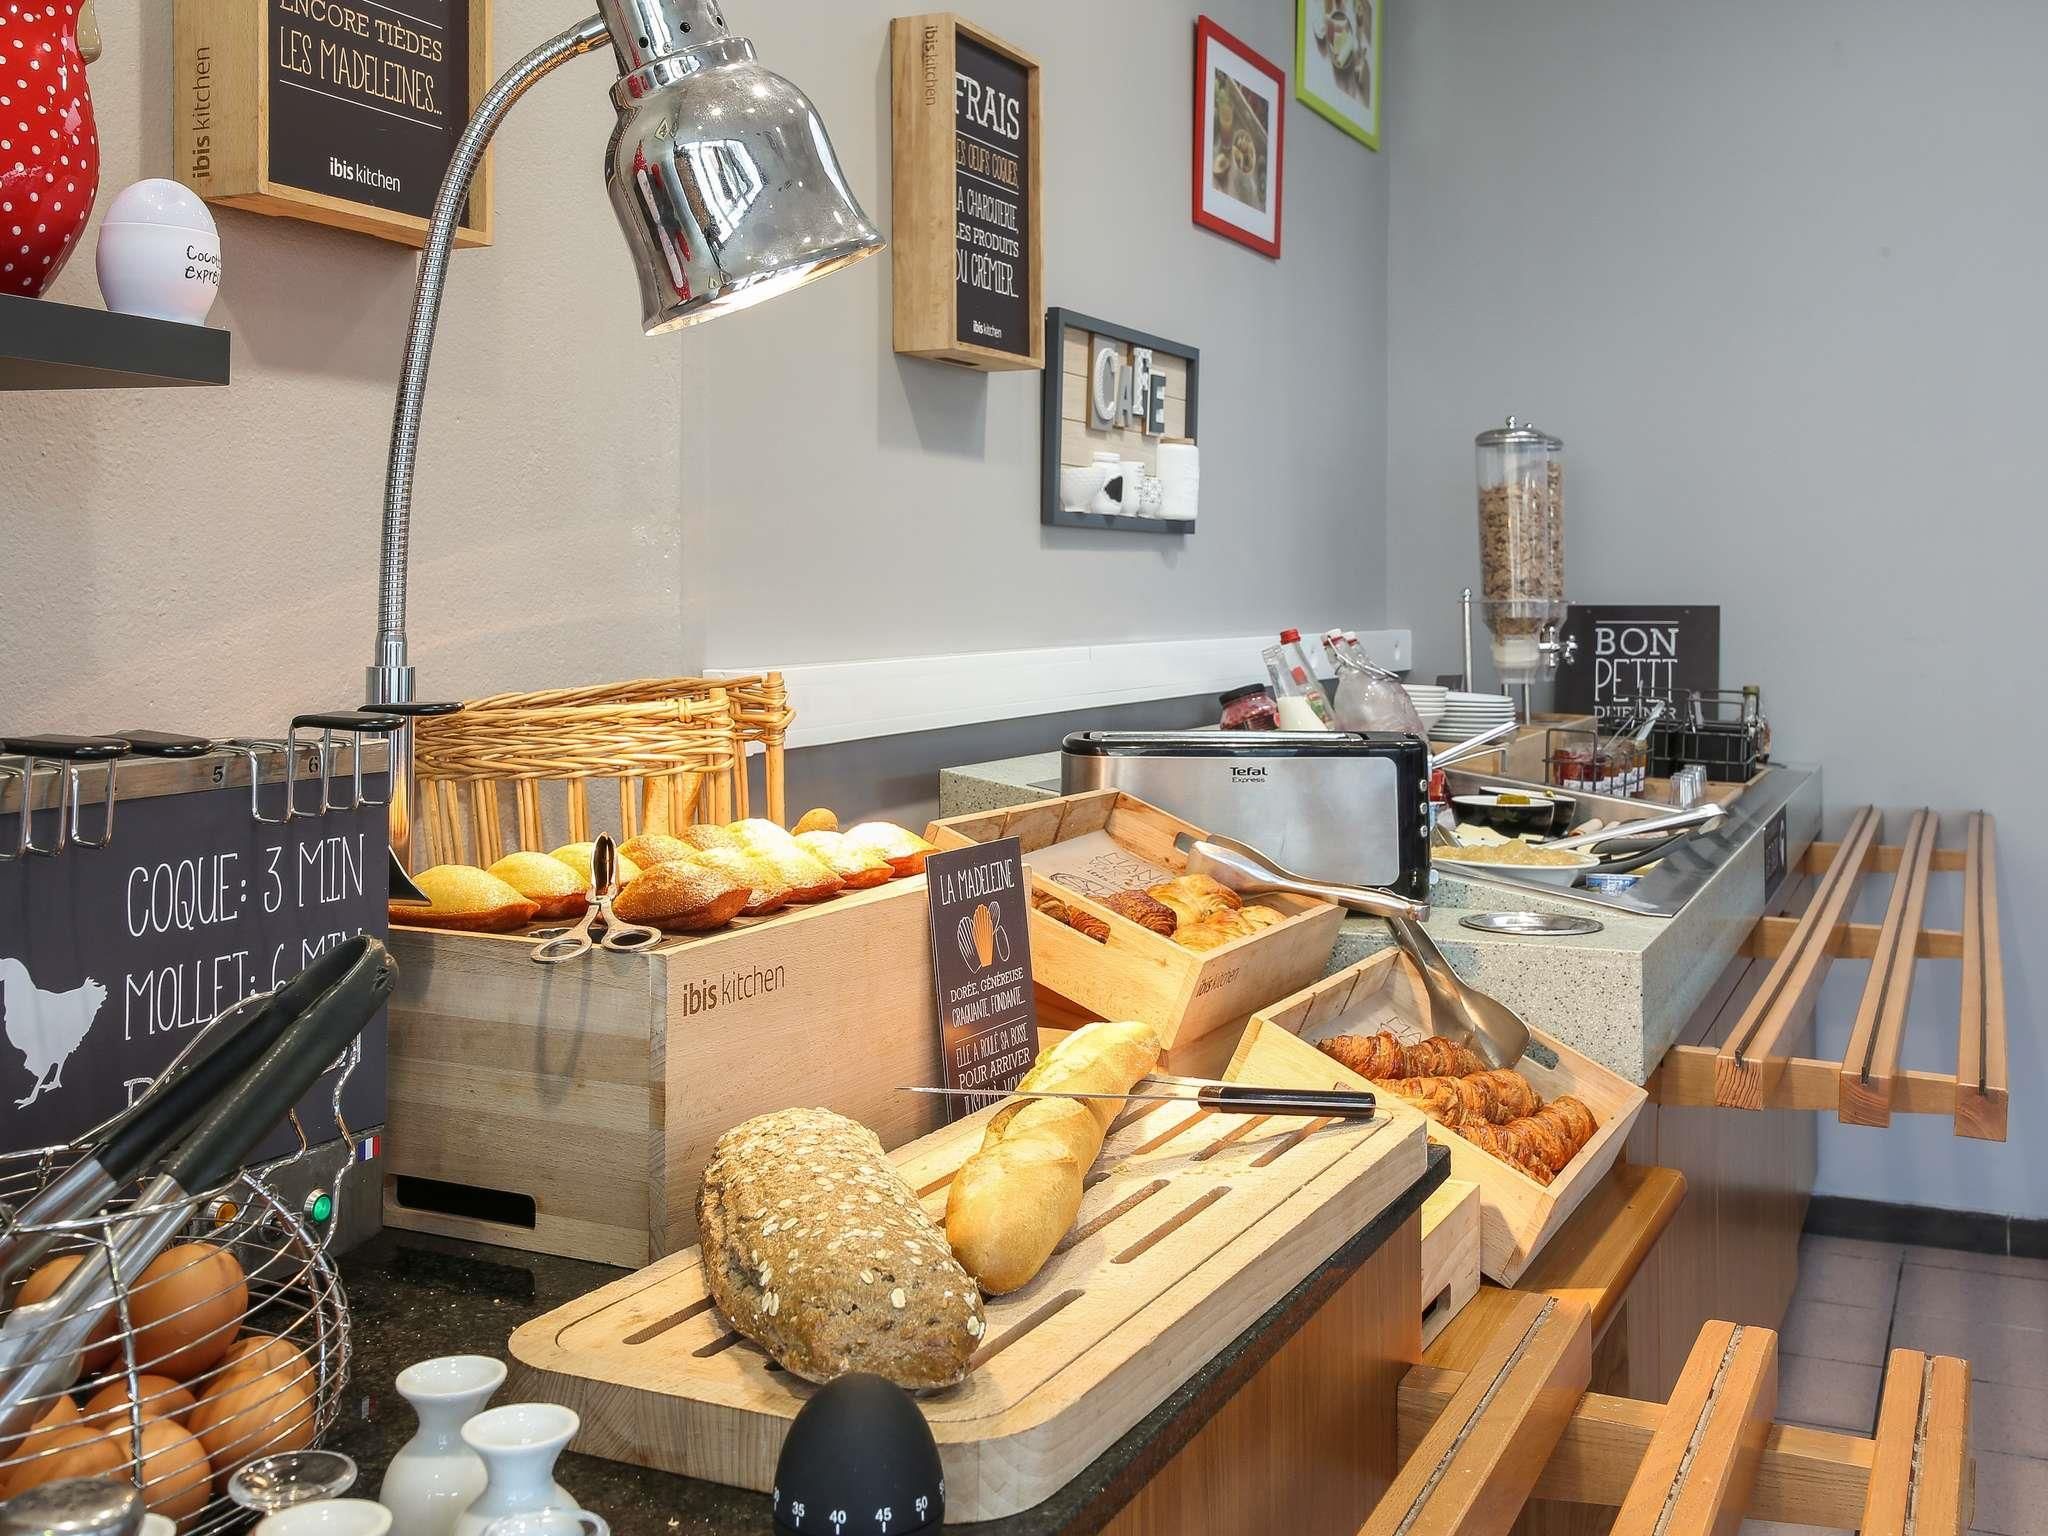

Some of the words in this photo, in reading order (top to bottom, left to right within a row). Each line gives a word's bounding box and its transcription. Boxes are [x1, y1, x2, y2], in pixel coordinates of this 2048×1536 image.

[374, 20, 442, 62] TIÈDES
[925, 25, 938, 52] ibis
[192, 46, 211, 131] kitchen
[280, 26, 312, 75] LES
[320, 39, 442, 116] MADELEINES...
[924, 53, 938, 106] kitchen
[955, 71, 1020, 141] FRAIS
[192, 136, 211, 178] ibis
[329, 157, 353, 181] ibis
[356, 164, 401, 192] kitchen
[972, 226, 1020, 258] PRODUITS
[1594, 627, 1679, 657] BON
[1594, 658, 1678, 703] PETIT
[212, 765, 225, 783] 5
[308, 756, 320, 773] 6
[1229, 766, 1268, 776] Tefal
[127, 852, 247, 937] COQUE:
[264, 846, 282, 913] 3
[299, 833, 365, 907] MIN
[940, 872, 956, 906] LA
[957, 858, 1015, 901] MADELEINE
[125, 950, 257, 1041] MOLLET:
[682, 978, 718, 1017] ibis
[721, 964, 785, 1006] kitchen
[950, 980, 980, 1003] DORÉE,
[980, 966, 1024, 992] GÉNÉREUSE
[955, 1044, 972, 1069] ELLE
[973, 1041, 980, 1062] A
[1000, 1029, 1010, 1051] SA
[958, 1064, 989, 1090] POUR
[989, 1046, 1031, 1079] ARRIVER
[792, 1500, 805, 1517] 35
[829, 1509, 847, 1524] 40
[875, 1507, 892, 1521] 45
[915, 1495, 928, 1512] 50
